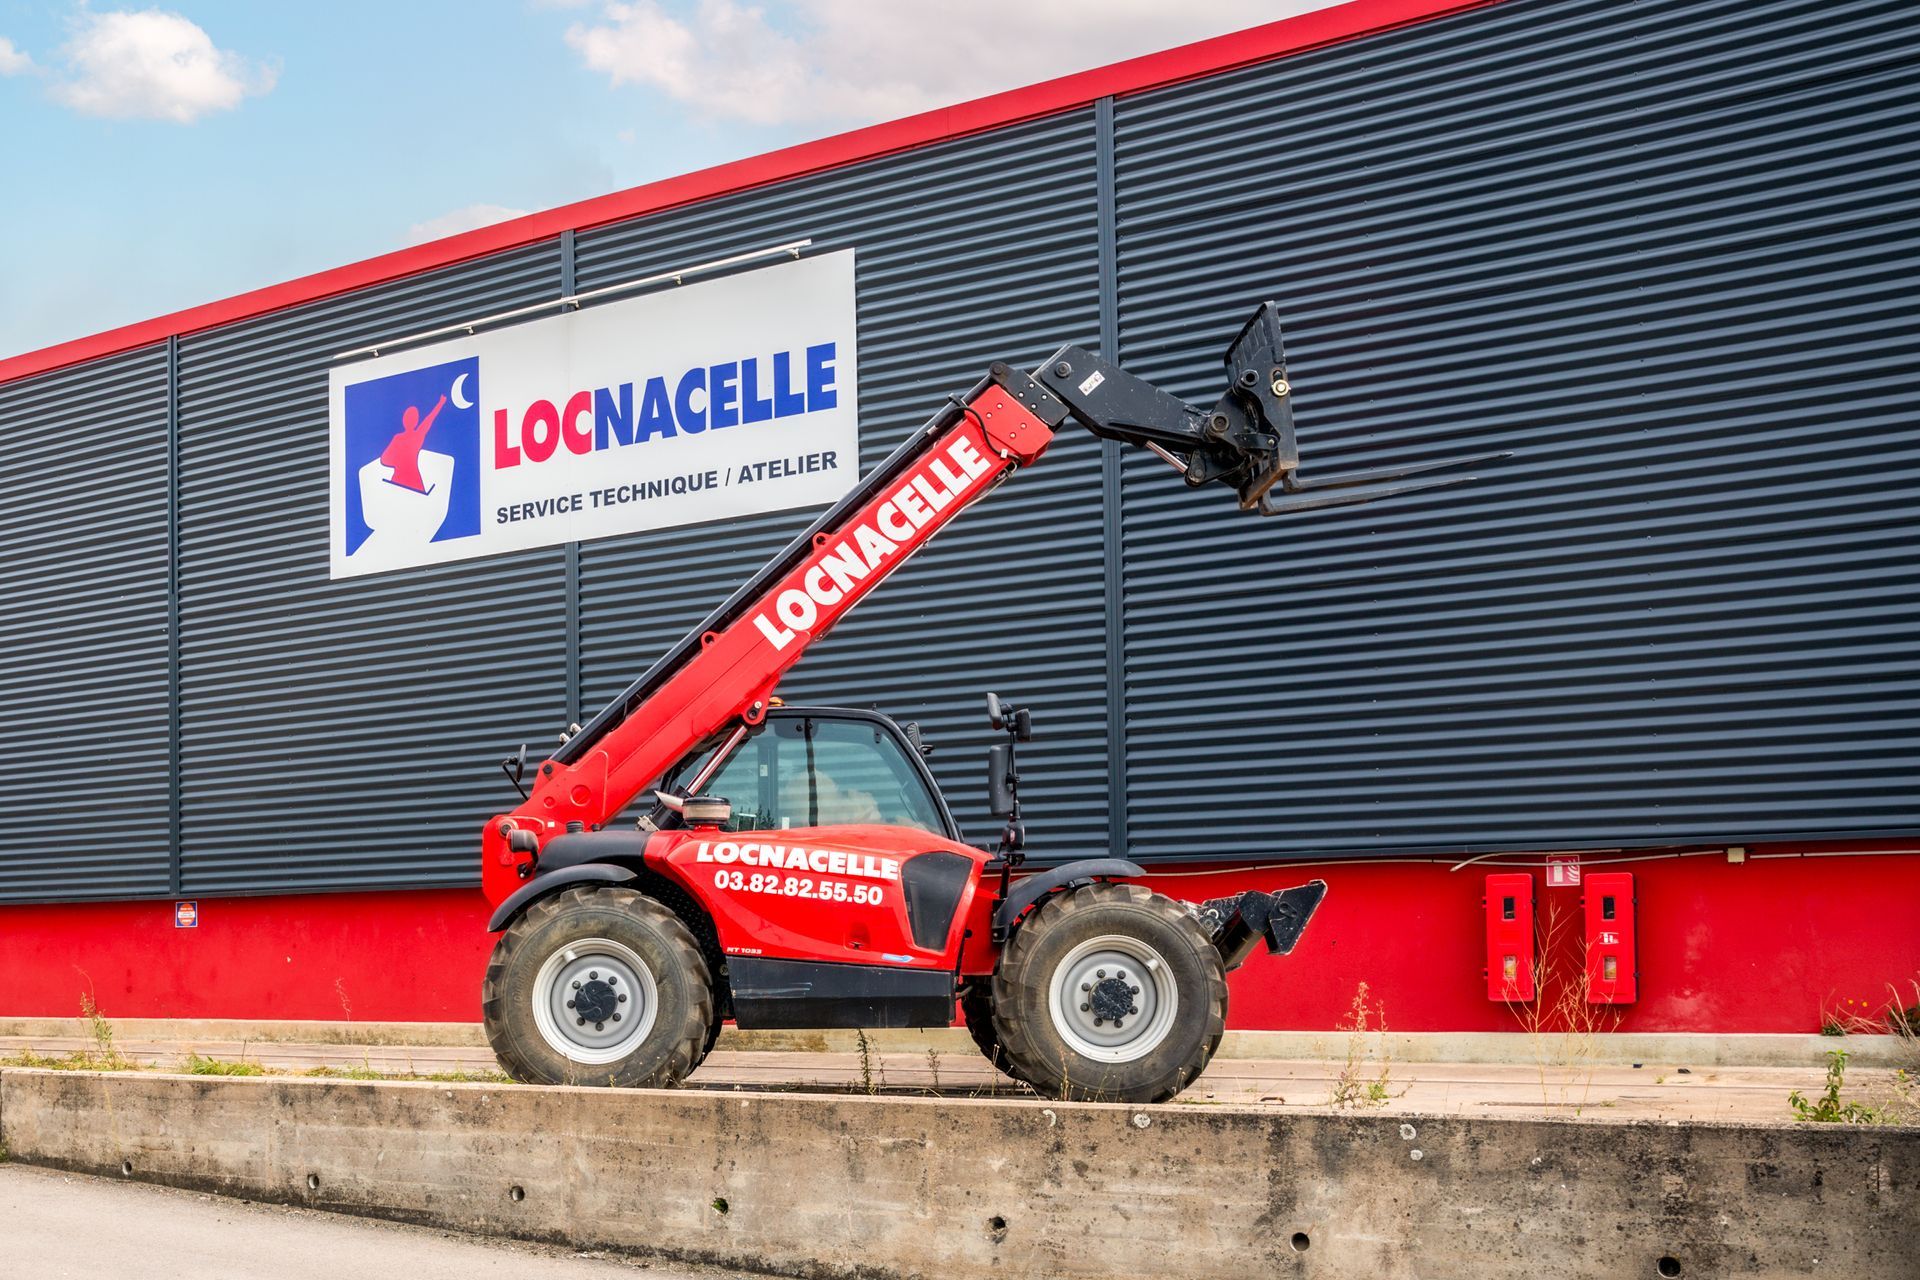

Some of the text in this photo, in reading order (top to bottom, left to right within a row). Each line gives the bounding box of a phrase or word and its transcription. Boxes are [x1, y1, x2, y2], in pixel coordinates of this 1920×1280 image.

[494, 341, 838, 470] LOCNACELLE
[496, 450, 838, 524] SERVICE TECHNIQUE / ATELIER
[753, 435, 991, 651] LOCNACELLE
[696, 842, 899, 880] LOCNACELLE
[714, 869, 883, 906] 03.82.82.55.50
